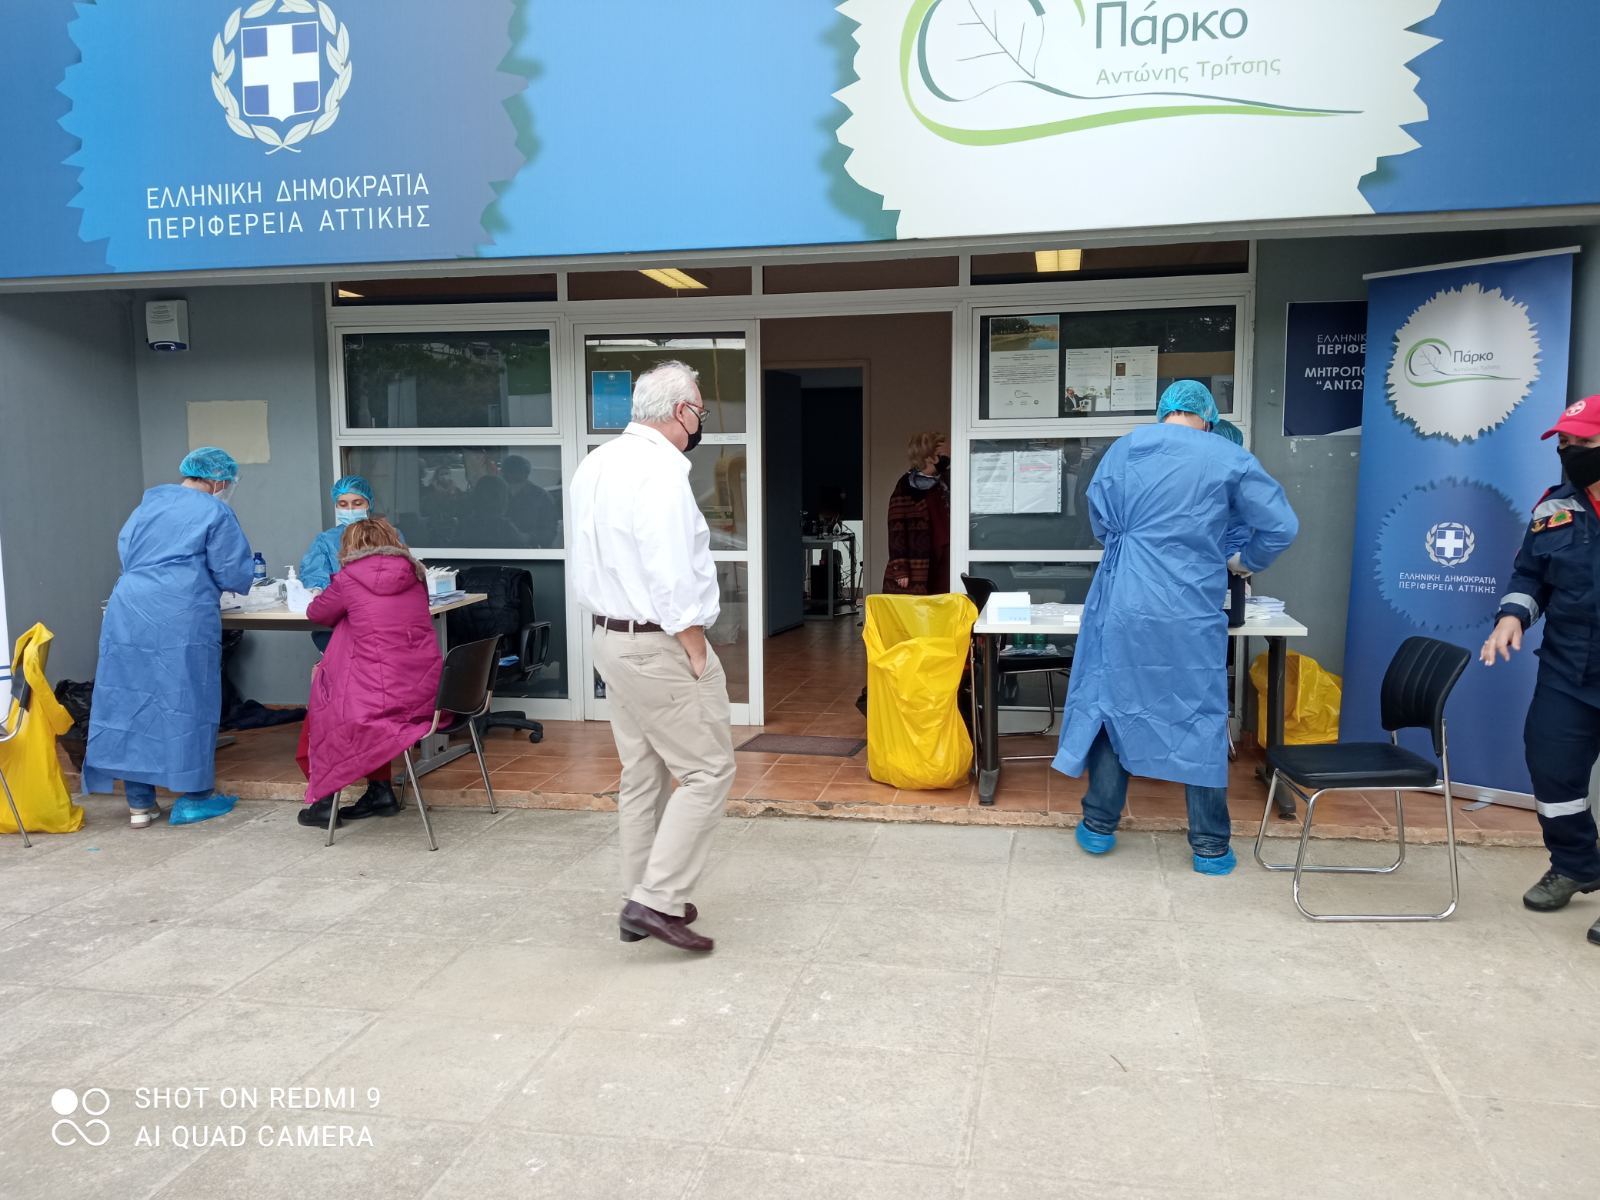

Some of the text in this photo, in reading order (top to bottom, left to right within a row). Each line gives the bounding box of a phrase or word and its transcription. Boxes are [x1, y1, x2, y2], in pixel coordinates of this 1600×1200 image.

[1096, 1, 1248, 54] Πάρκο
[1096, 56, 1281, 85] Αντώνης Τρίτσης
[147, 173, 429, 209] ΕΛΛΗΝΙΚΗ ΔΗΜΟΚΡΑΤΙΑ
[148, 205, 430, 239] ΠΕΡΙΦΕΡΕΙΑ ΑΤΤΙΚΗΣ
[1453, 350, 1494, 364] Πάρκο
[1398, 581, 1496, 594] ΠΕΡΙΦΕΡΕΙΑ ΑΤΤΙΚΗΣ
[1399, 572, 1497, 584] ΕΛΛΗΝΙΚΗ ΔΗΜΟΚΡΑΤΙΑ
